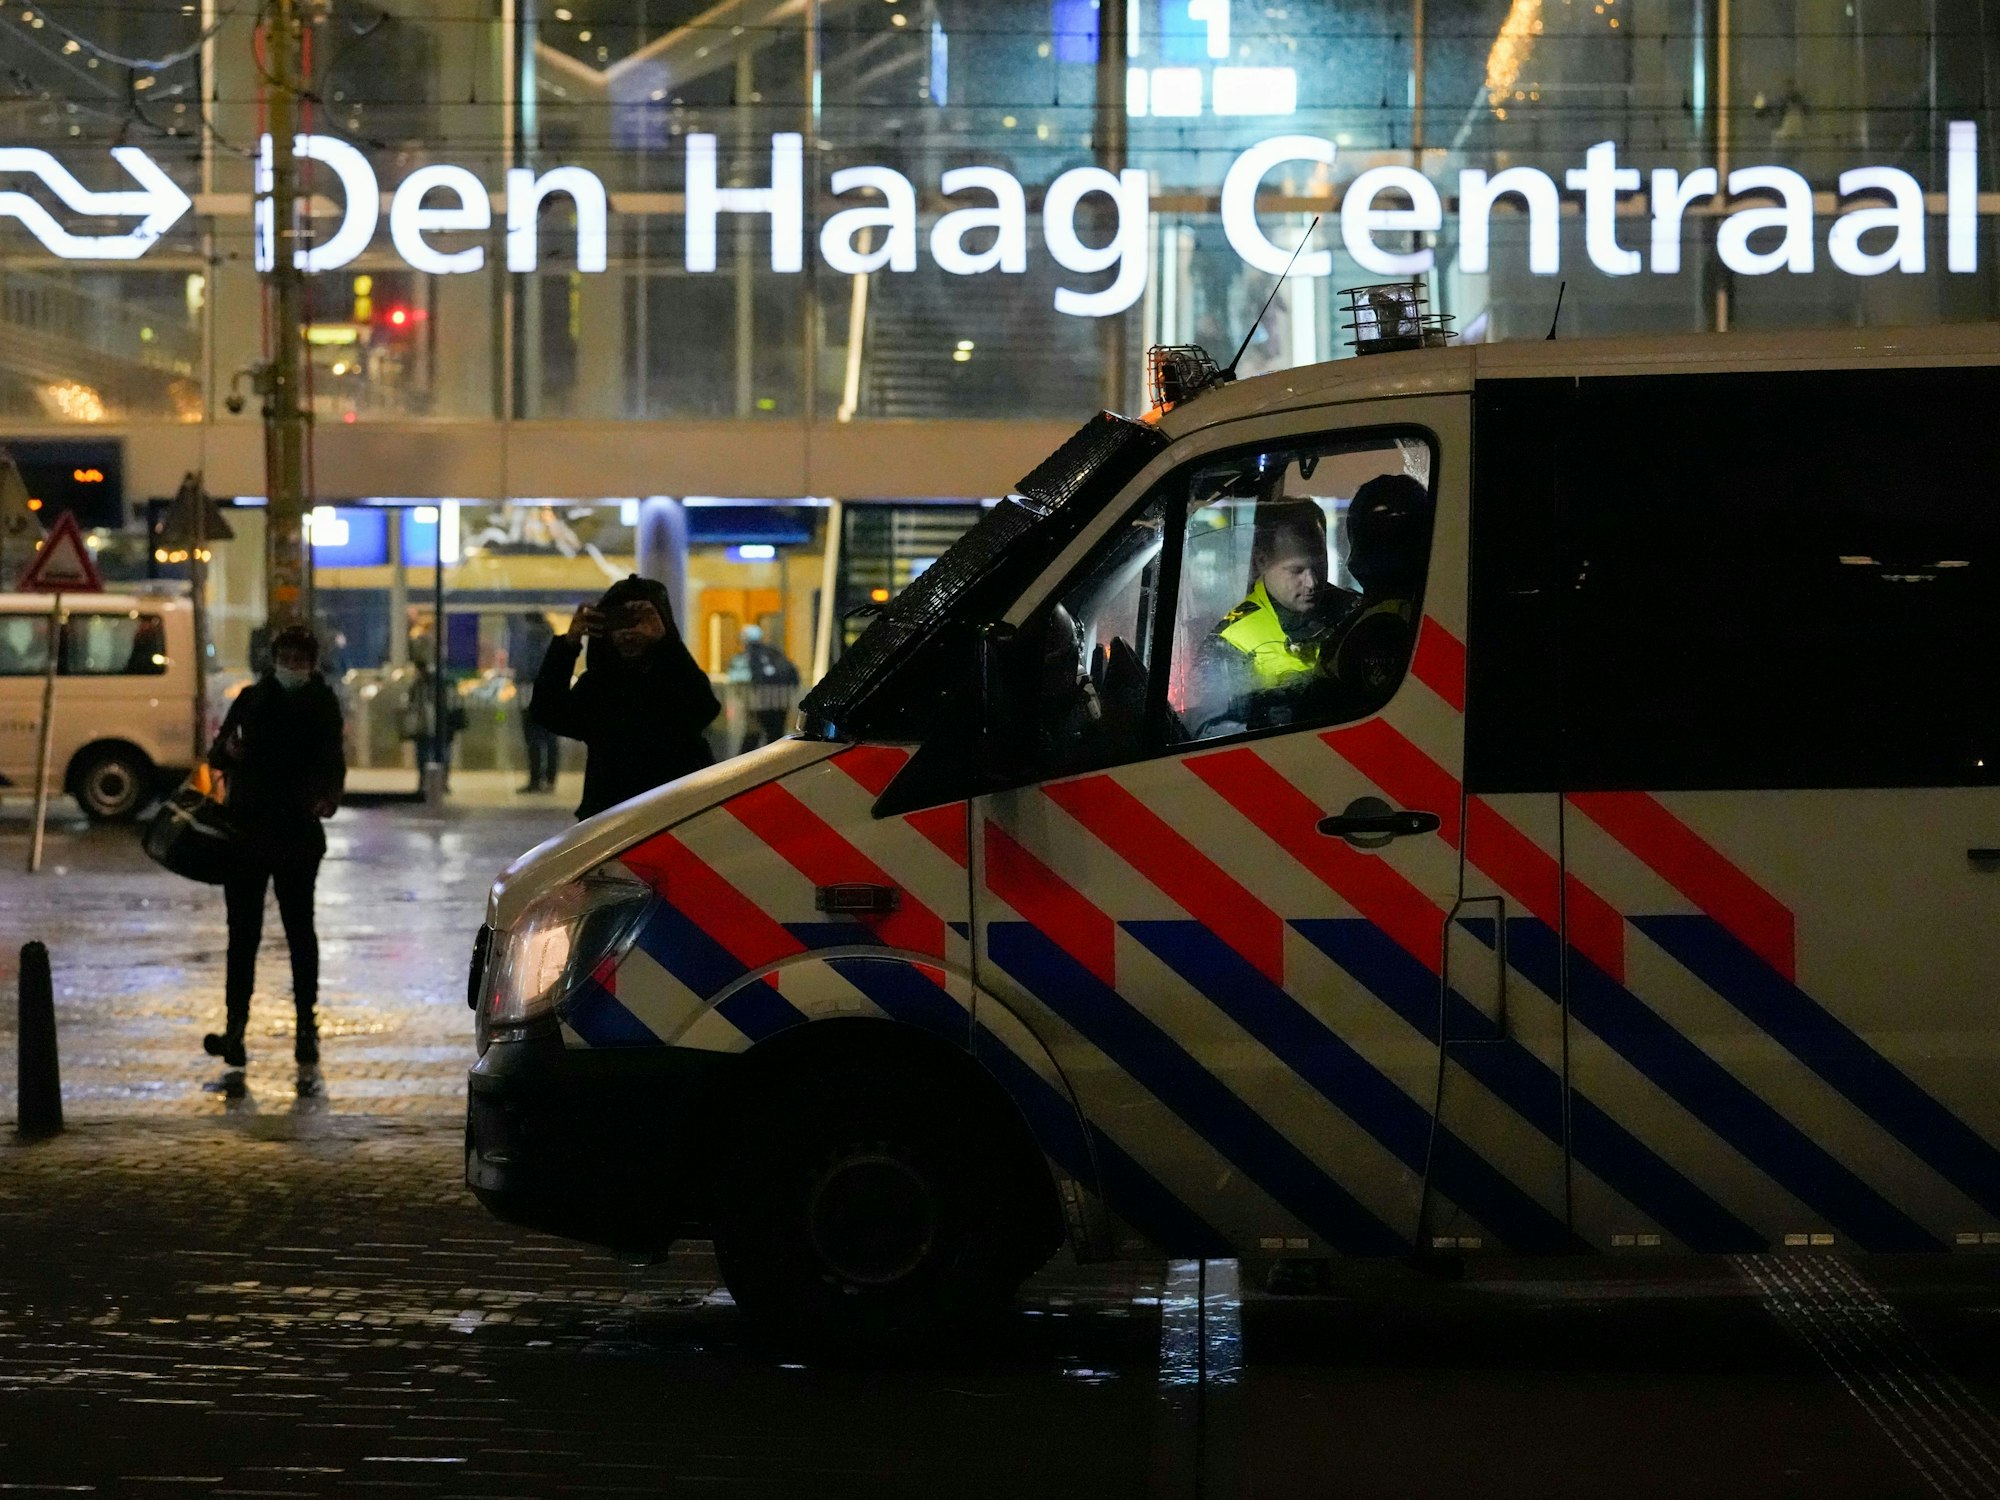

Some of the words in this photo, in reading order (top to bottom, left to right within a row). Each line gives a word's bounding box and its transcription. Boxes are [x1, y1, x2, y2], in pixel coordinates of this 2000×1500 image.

[255, 134, 607, 274] Den
[685, 132, 1149, 318] Haag
[1221, 120, 1978, 276] Centraal
